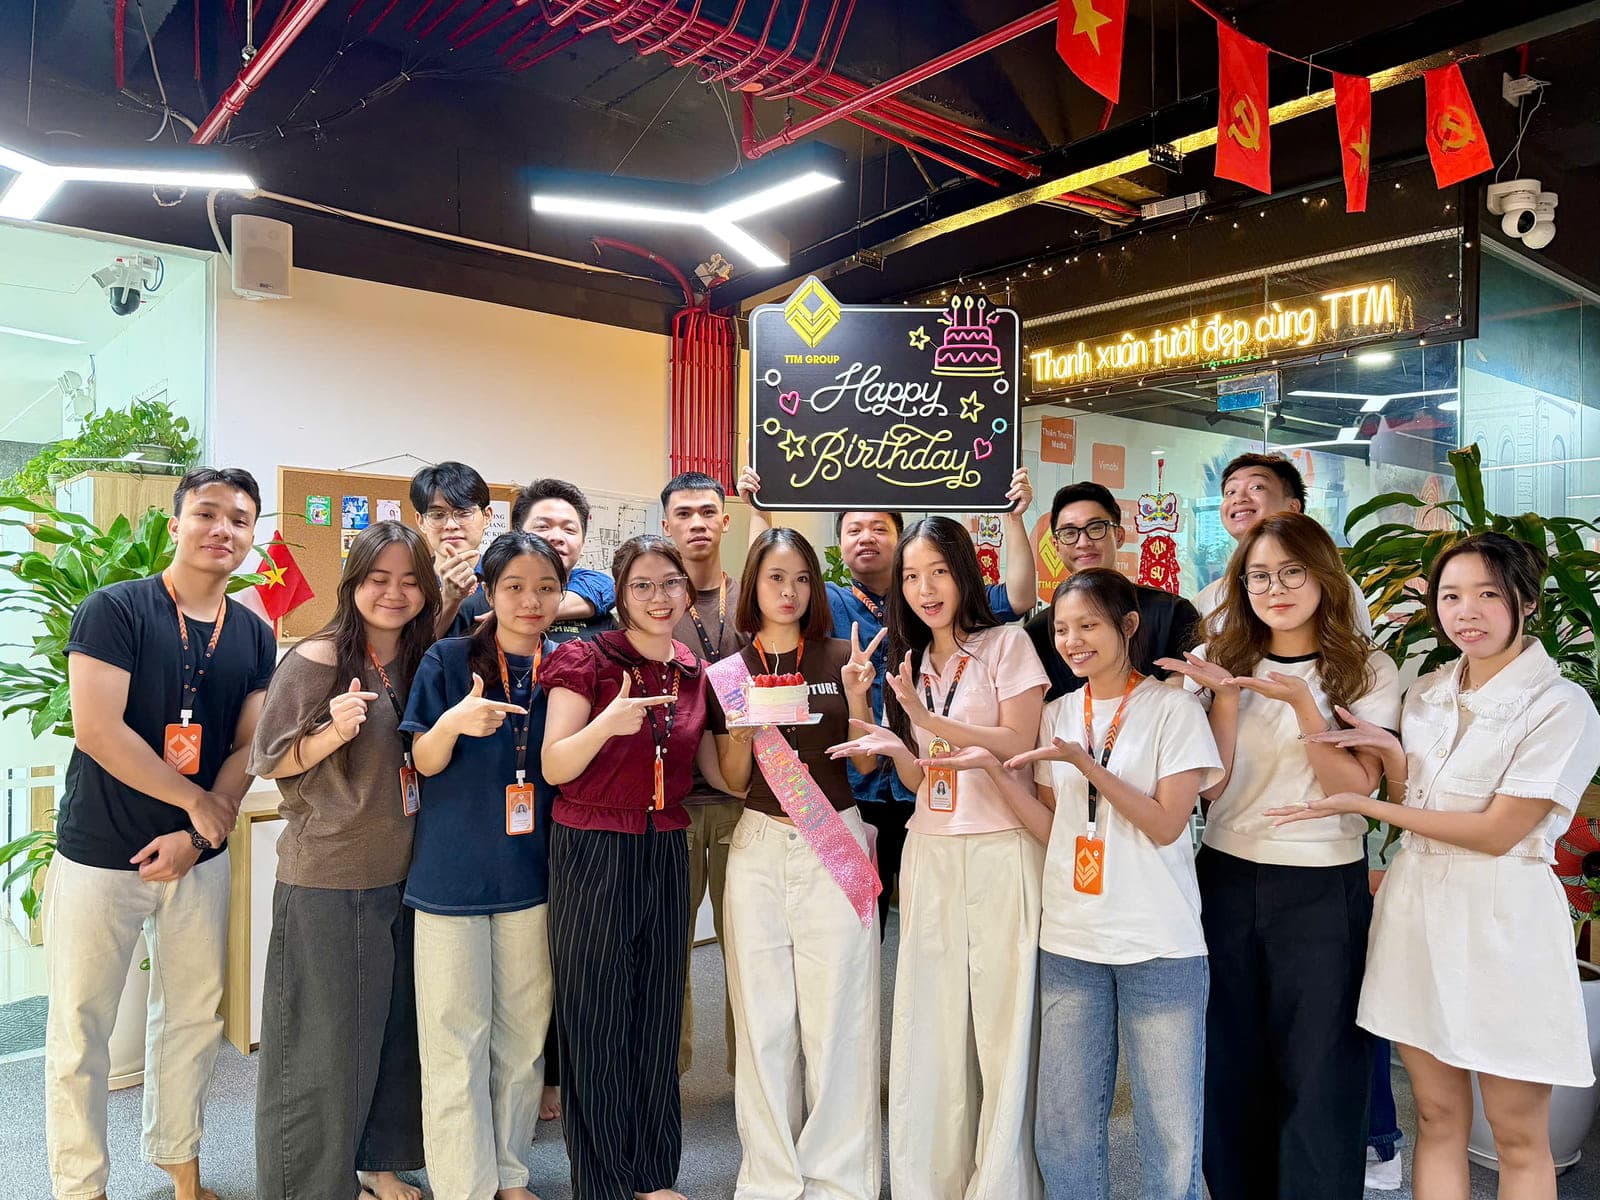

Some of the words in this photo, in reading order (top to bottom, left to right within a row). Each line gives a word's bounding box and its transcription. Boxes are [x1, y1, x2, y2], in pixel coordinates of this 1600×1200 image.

[784, 355, 803, 364] TTM
[805, 355, 840, 364] GROUP
[1030, 342, 1091, 381] Thanh
[1096, 333, 1147, 369] xuân
[1202, 313, 1250, 358] đẹp
[1255, 302, 1316, 346] cùng
[1321, 284, 1394, 330] TTM
[810, 362, 949, 416] Happy
[790, 423, 982, 489] Birthday
